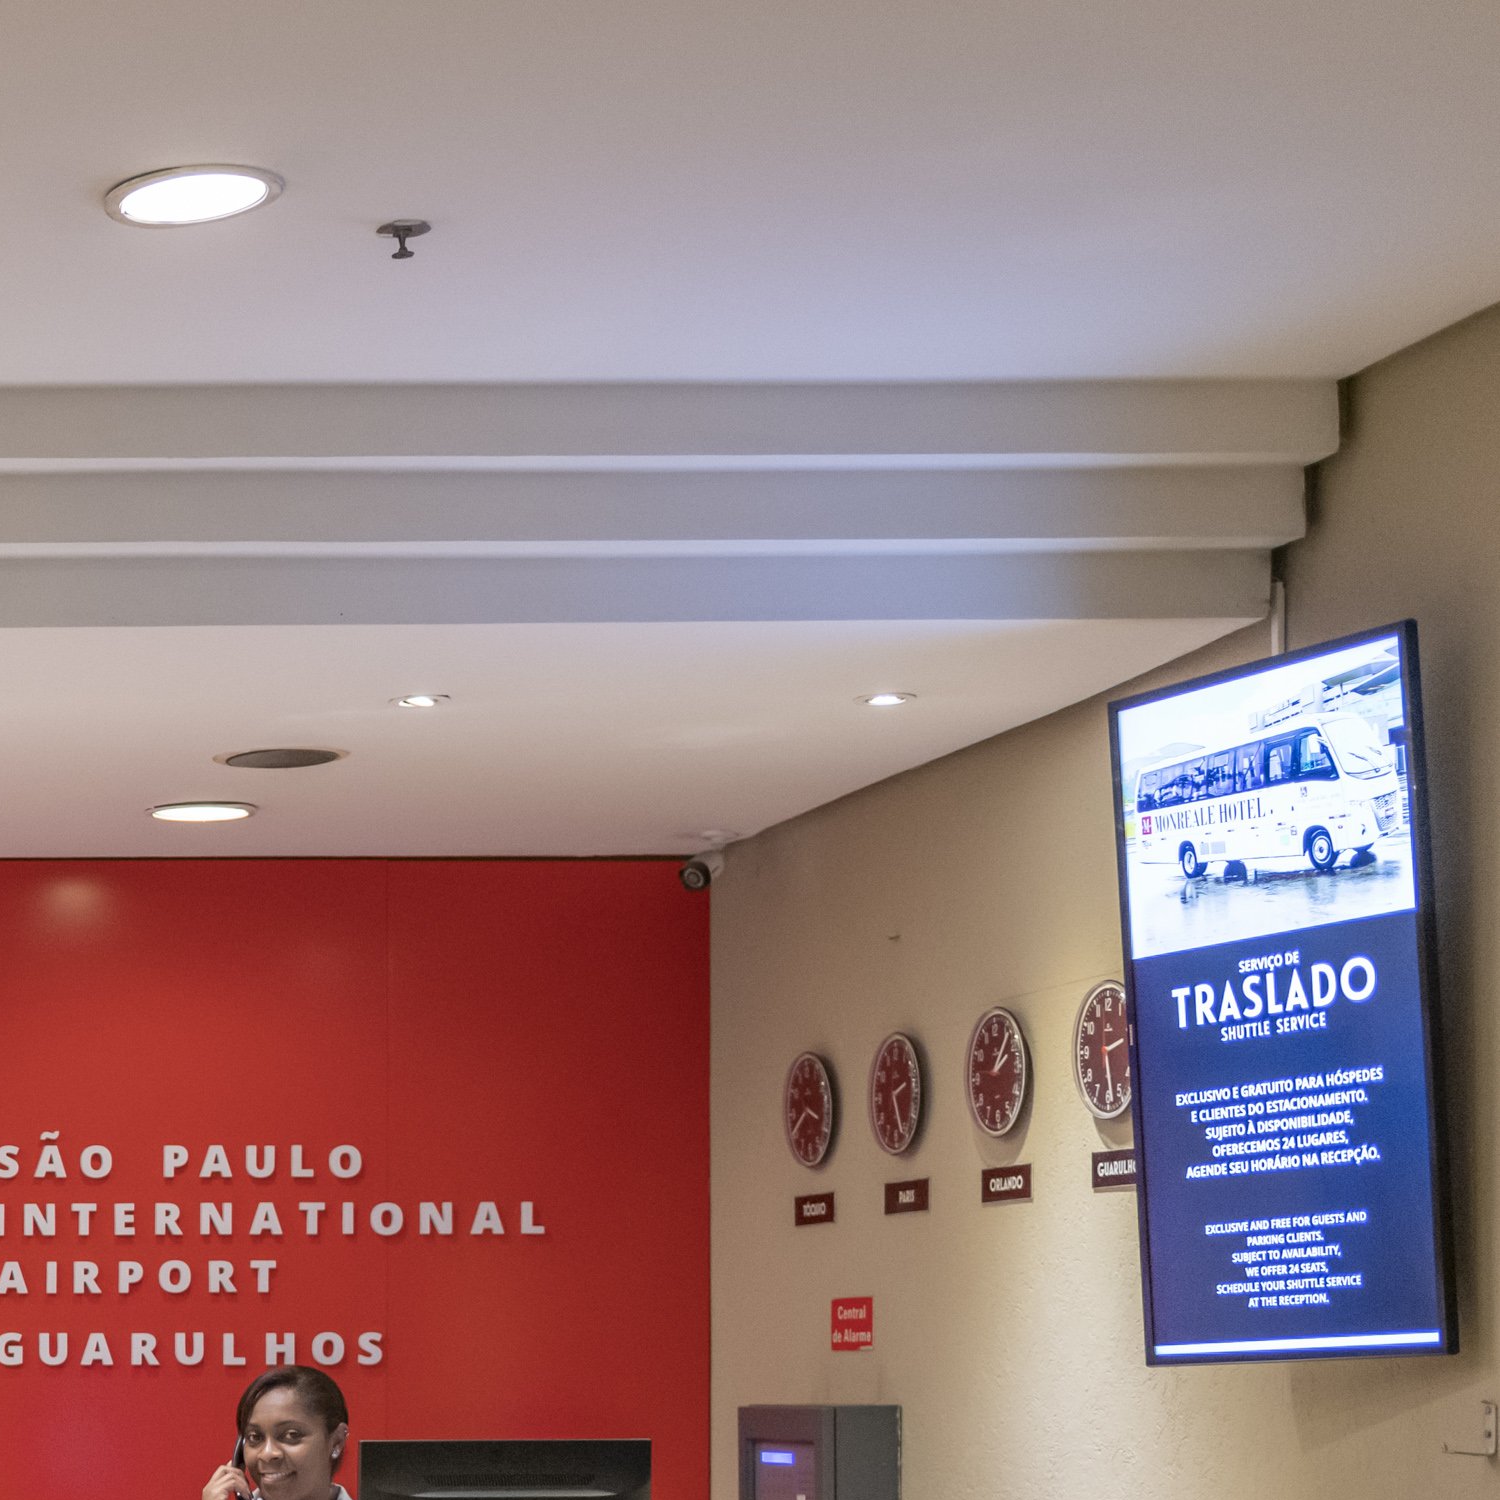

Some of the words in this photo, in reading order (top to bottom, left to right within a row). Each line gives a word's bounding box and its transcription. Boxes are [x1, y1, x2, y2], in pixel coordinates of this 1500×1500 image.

[1155, 805, 1215, 832] MONREALE
[1219, 798, 1265, 823] HOTEL
[1239, 954, 1283, 973] SERVIÇO
[1285, 951, 1299, 965] DE
[1172, 957, 1375, 1028] TRASLADO
[1096, 1005, 1100, 1017] 11
[1105, 998, 1112, 1011] 12
[1119, 1004, 1122, 1016] 1
[992, 1024, 998, 1036] 12
[1087, 1022, 1094, 1035] 10
[1221, 1021, 1270, 1041] SHUTTLE
[1276, 1012, 1326, 1033] SERVICE
[1084, 1046, 1089, 1059] 9
[1087, 1069, 1092, 1081] 8
[1095, 1084, 1099, 1098] 7
[1117, 1084, 1122, 1097] 5
[1176, 1088, 1230, 1106] EXCLUSIVO
[1233, 1087, 1239, 1098] E
[1241, 1080, 1293, 1097] GRATUITO
[1296, 1075, 1323, 1090] PARA
[1326, 1067, 1383, 1086] HÓSPEDES
[1105, 1090, 1110, 1103] 6
[1191, 1111, 1198, 1122] E
[1200, 1105, 1246, 1121] CLIENTES
[1248, 1104, 1264, 1115] DO
[1267, 1090, 1368, 1113] ESTACIONAMENTO.
[1206, 1124, 1245, 1141] SUJEITO
[1247, 1121, 1255, 1134] À
[1258, 1111, 1354, 1133] DISPONIBILIDADE,
[1213, 1140, 1280, 1157] OFERECEMOS
[1282, 1139, 1295, 1149] 24
[1298, 1131, 1348, 1148] LUGARES,
[163, 1145, 363, 1178] PAULO
[1186, 1165, 1227, 1179] AGENDE
[1229, 1162, 1248, 1174] SEU
[1251, 1155, 1299, 1171] HORÁRIO
[1302, 1154, 1318, 1166] NA
[1321, 1145, 1380, 1166] RECEPÇÃO.
[989, 1174, 1023, 1192] ORLANDO
[899, 1190, 915, 1203] PARIS
[1205, 1222, 1248, 1235] EXCLUSIVE
[1250, 1220, 1269, 1230] AND
[1271, 1219, 1291, 1228] FREE
[1293, 1217, 1310, 1227] FOR
[1312, 1214, 1344, 1225] GUESTS
[1346, 1212, 1366, 1222] AND
[1247, 1234, 1284, 1246] PARKING
[1286, 1231, 1324, 1243] CLIENTS.
[1232, 1251, 1267, 1263] SUBJECT
[1269, 1250, 1280, 1259] TO
[1282, 1245, 1341, 1258] AVAILABILITY,
[1245, 1268, 1259, 1276] WE
[1261, 1266, 1287, 1275] OFFER
[1289, 1265, 1299, 1273] 24
[1301, 1262, 1328, 1273] SEATS,
[1217, 1283, 1259, 1294] SCHEDULE
[1261, 1281, 1285, 1291] YOUR
[1287, 1278, 1324, 1289] SHUTTLE
[1326, 1275, 1361, 1287] SERVICE
[1248, 1298, 1260, 1307] AT
[1262, 1296, 1277, 1306] THE
[1279, 1294, 1329, 1305] RECEPTION.
[838, 1305, 866, 1319] Central
[833, 1329, 842, 1343] de
[844, 1328, 871, 1342] Alarme
